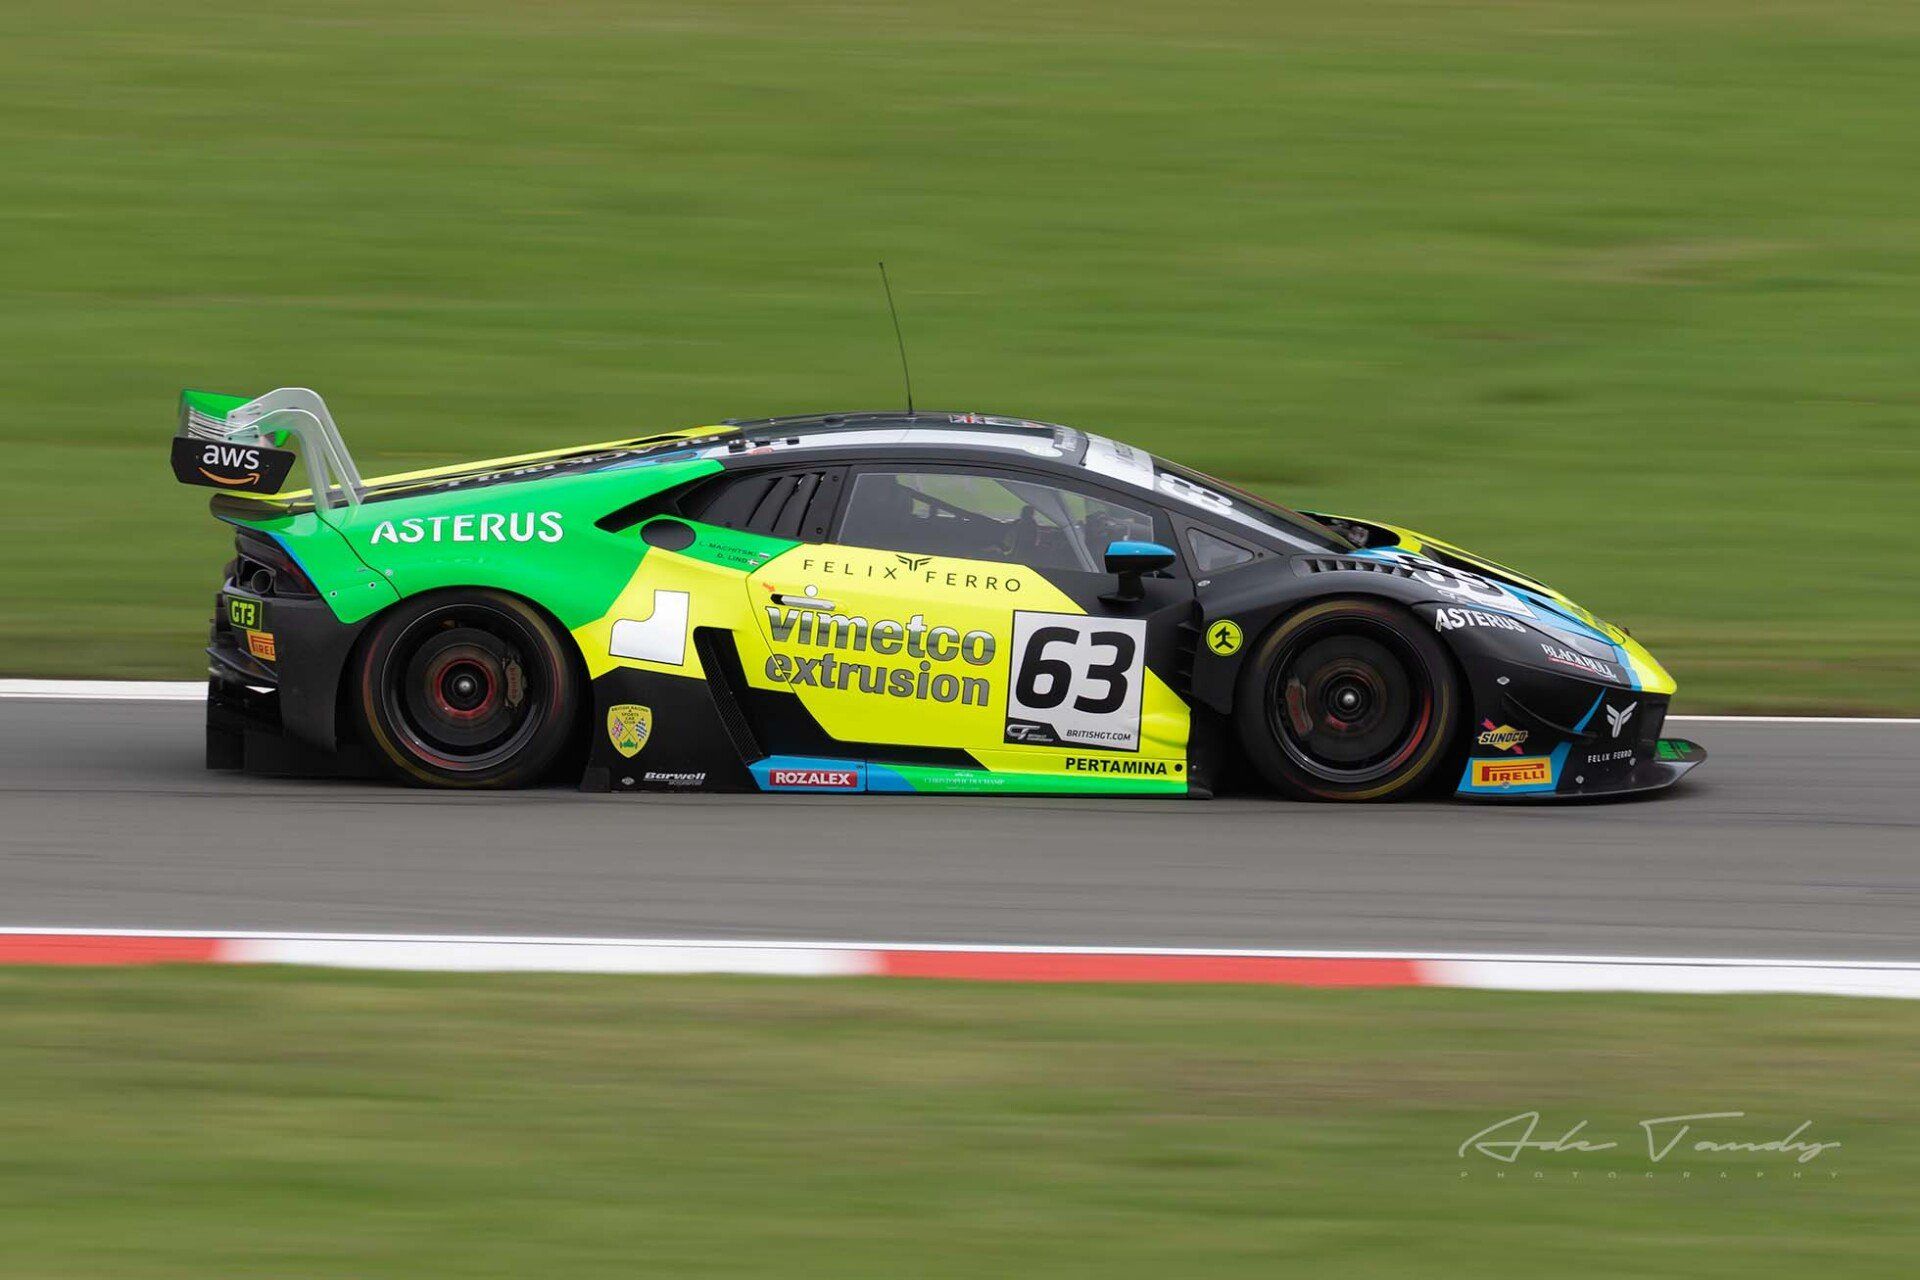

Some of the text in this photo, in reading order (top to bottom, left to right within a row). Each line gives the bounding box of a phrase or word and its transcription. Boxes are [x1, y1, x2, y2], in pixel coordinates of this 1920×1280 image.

[202, 444, 260, 470] aws
[370, 511, 564, 544] ASTERUS
[803, 559, 1022, 593] FELIX FERRO
[231, 600, 255, 626] GT3
[765, 585, 996, 666] vimetco
[1435, 608, 1527, 634] ASTERUS
[765, 652, 990, 707] extrusion
[1015, 626, 1136, 714] 63
[1066, 729, 1131, 741] BRITISHGT.COM
[1479, 731, 1528, 744] SUNOCO
[1065, 757, 1167, 775] PERTAMINA
[1588, 750, 1632, 763] FELIX FERRO
[644, 771, 706, 780] Barwell
[775, 772, 851, 785] ROZALEX
[1481, 763, 1545, 782] PIRELLI
